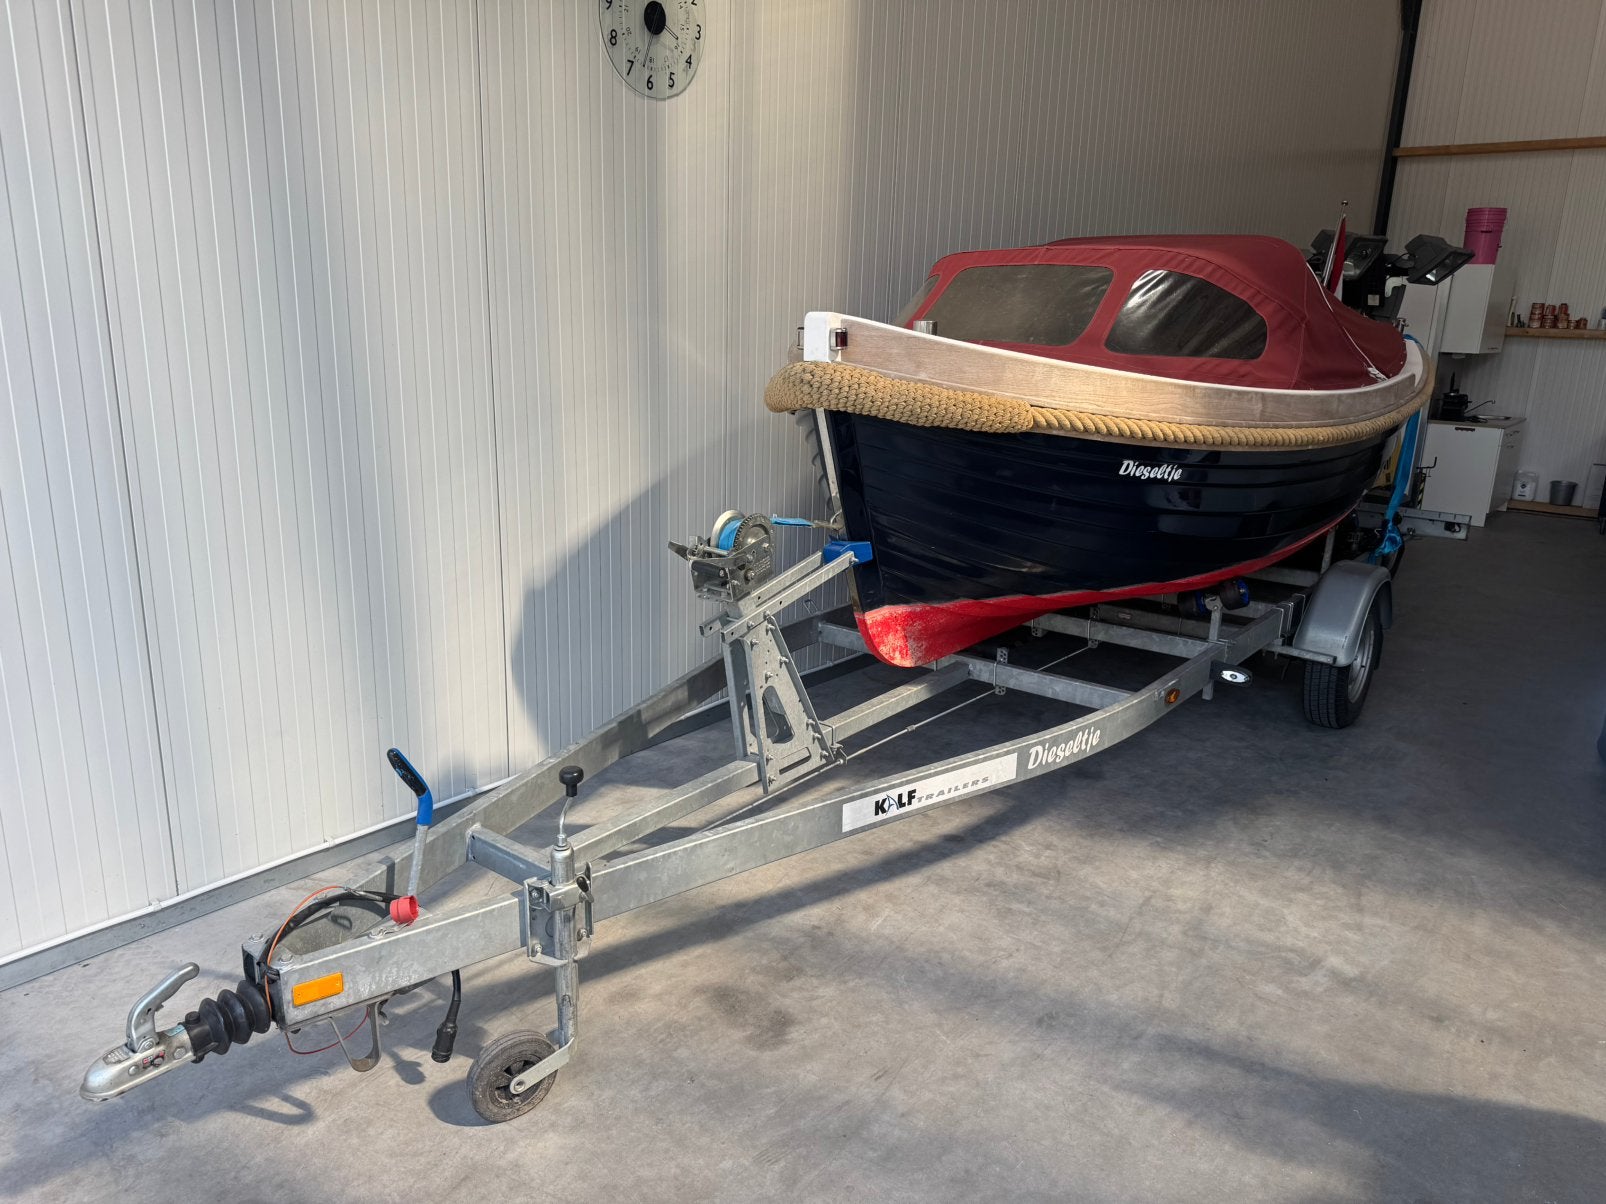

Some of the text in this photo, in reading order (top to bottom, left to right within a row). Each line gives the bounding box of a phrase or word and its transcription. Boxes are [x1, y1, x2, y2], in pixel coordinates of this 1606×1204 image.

[609, 28, 618, 46] 8
[695, 24, 702, 40] 3
[627, 59, 635, 76] 7
[685, 54, 693, 69] 4
[646, 74, 654, 91] 6
[668, 72, 676, 88] 5
[1119, 460, 1183, 482] Dieseltje
[1028, 726, 1101, 770] Dieseltje
[874, 776, 990, 816] KALF TRAILERS
